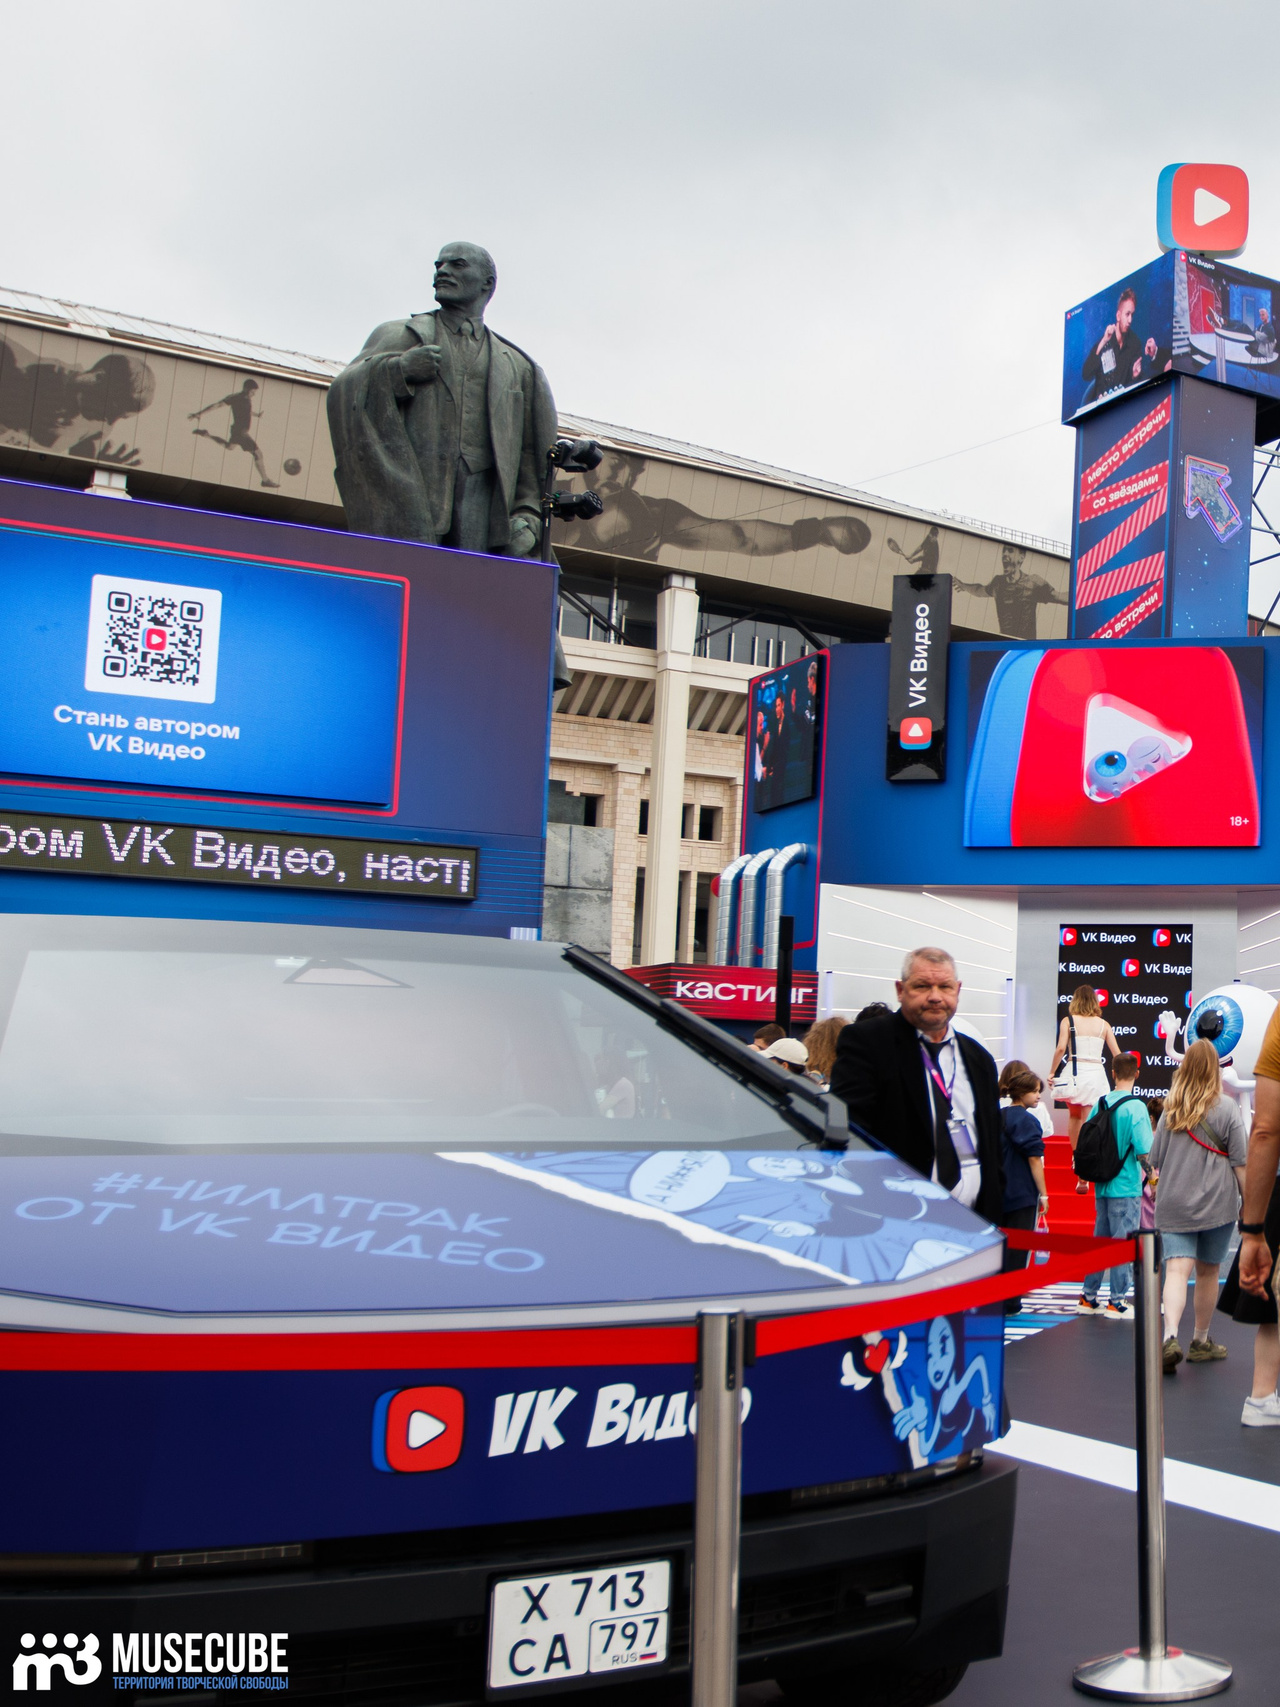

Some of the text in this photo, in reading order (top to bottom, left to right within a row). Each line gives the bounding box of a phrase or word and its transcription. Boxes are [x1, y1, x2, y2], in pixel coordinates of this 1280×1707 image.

[1087, 409, 1167, 484] место встречи
[1092, 473, 1160, 509] со звёздами
[1114, 591, 1160, 632] встречи
[908, 603, 932, 708] VK Видео
[53, 704, 241, 740] Стань автором
[88, 731, 207, 762] VK Видео
[1229, 815, 1250, 827] 18+
[102, 823, 175, 866] VK
[1081, 932, 1137, 944] VK Видео
[1175, 933, 1192, 944] VK
[1068, 962, 1106, 974] Видео
[1144, 963, 1161, 974] VK
[1113, 993, 1169, 1005] VK Видео
[1145, 1055, 1163, 1066] VK
[1132, 1086, 1170, 1098] Видео
[15, 1196, 546, 1273] ОТ VK ВИДЕО
[488, 1386, 579, 1457] VK
[571, 1570, 645, 1617] 713
[600, 1617, 659, 1654] 797
[612, 1653, 638, 1666] RUS
